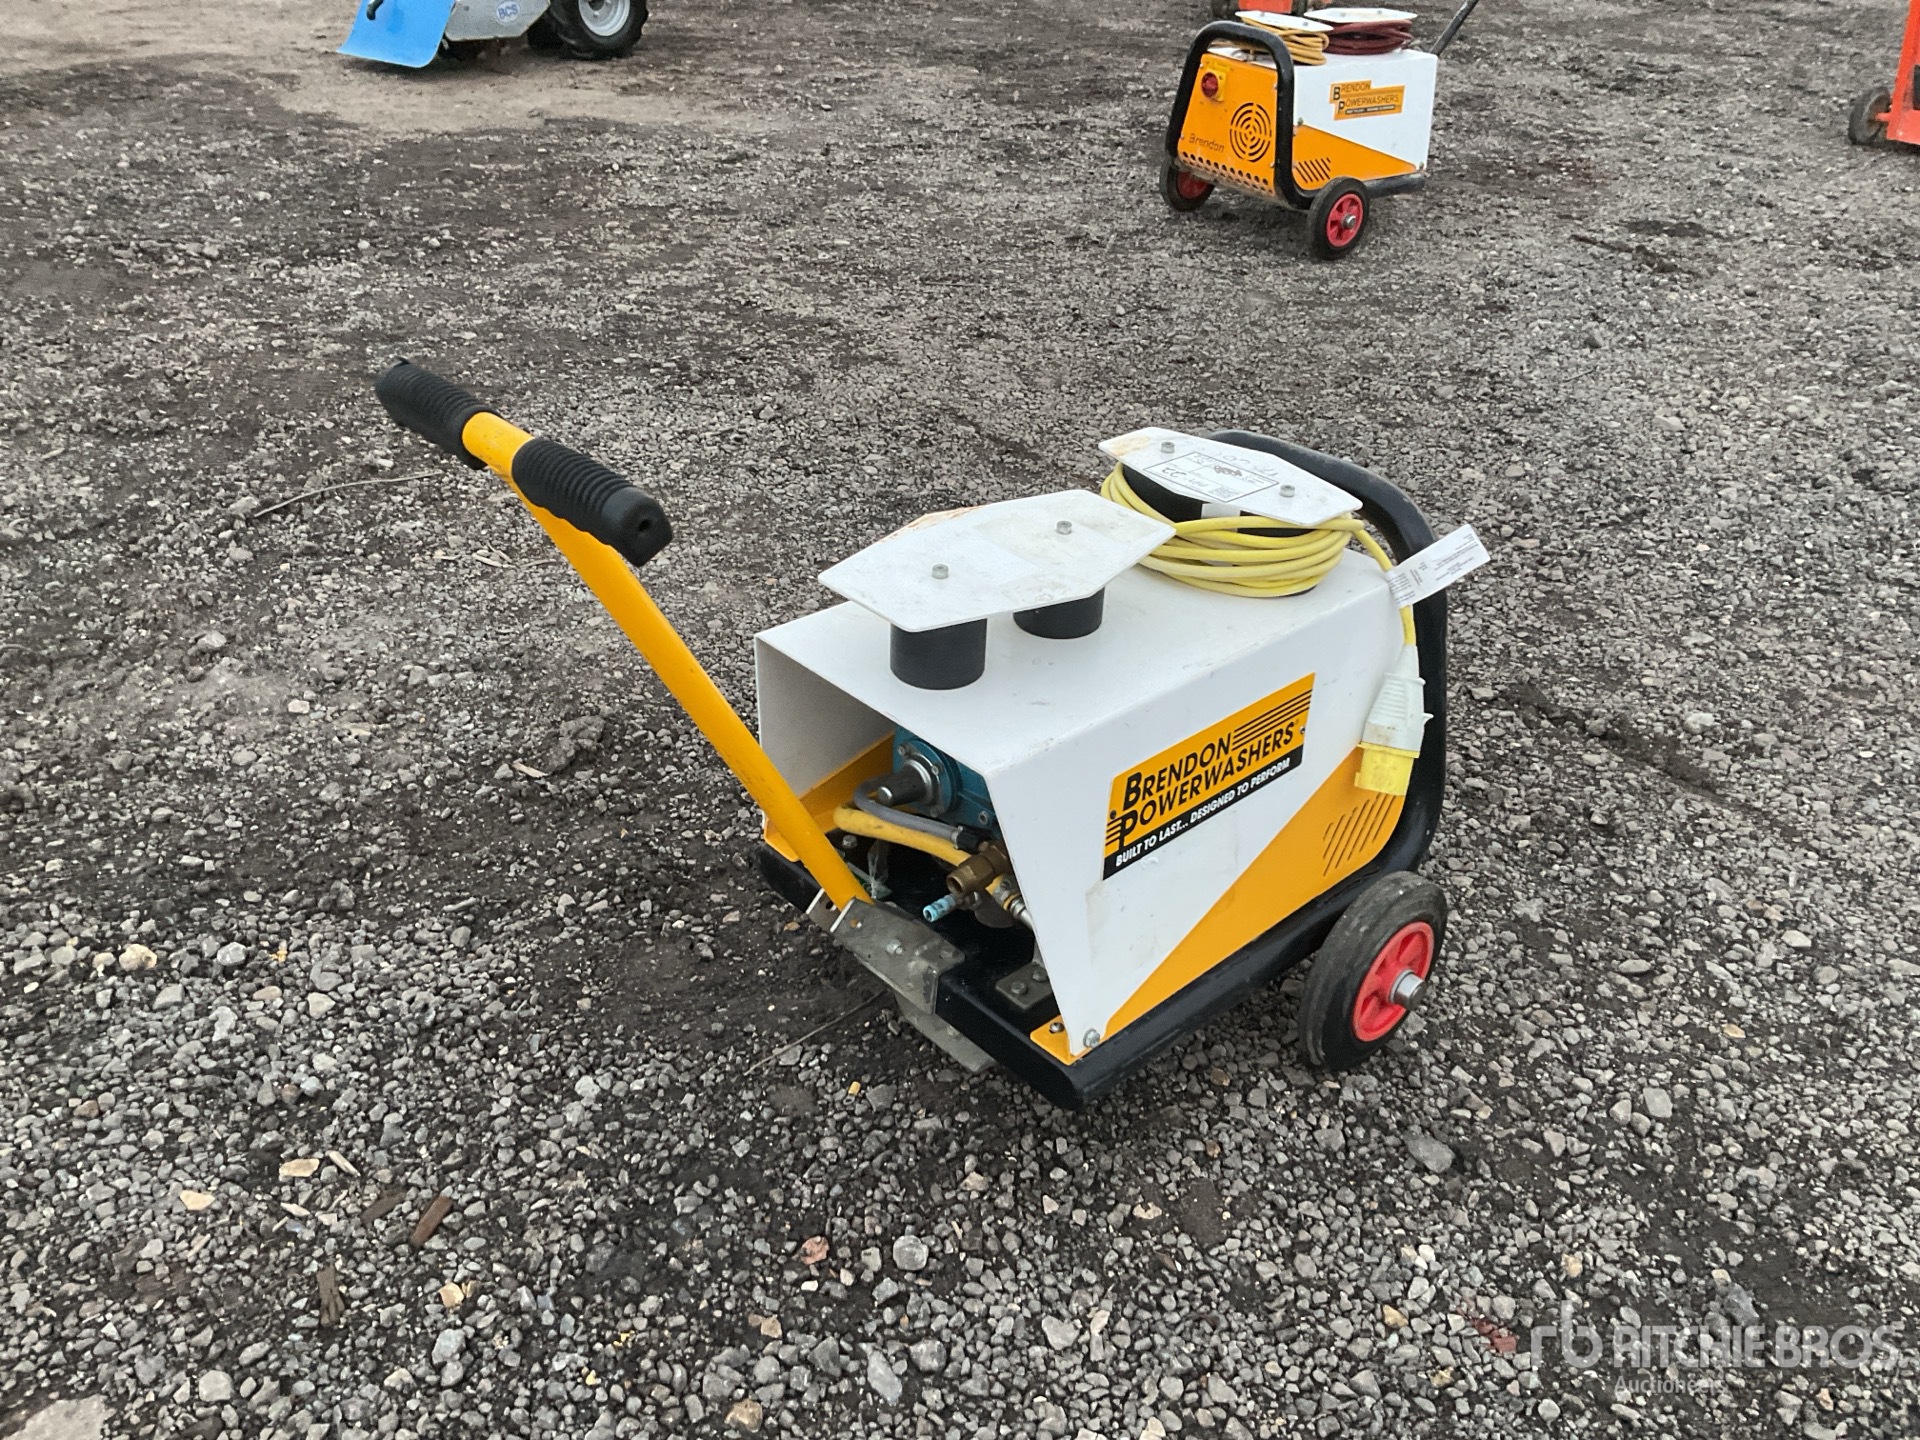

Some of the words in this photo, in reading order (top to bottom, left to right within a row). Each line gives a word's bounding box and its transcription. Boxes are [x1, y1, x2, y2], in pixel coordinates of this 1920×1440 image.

[497, 4, 518, 19] BCS
[1333, 82, 1371, 101] BRENDON
[1338, 94, 1399, 114] POWERWASHERS
[1188, 133, 1225, 152] Brendon
[1123, 731, 1233, 811] BRENDON
[1118, 721, 1295, 850] POWERWASHERS
[1115, 843, 1143, 867] BUILT
[1144, 835, 1158, 851] TO
[1158, 820, 1189, 842] LAST...
[1190, 789, 1236, 824] DESIGNED
[1236, 781, 1250, 796] TO
[1250, 757, 1291, 788] PERFORM
